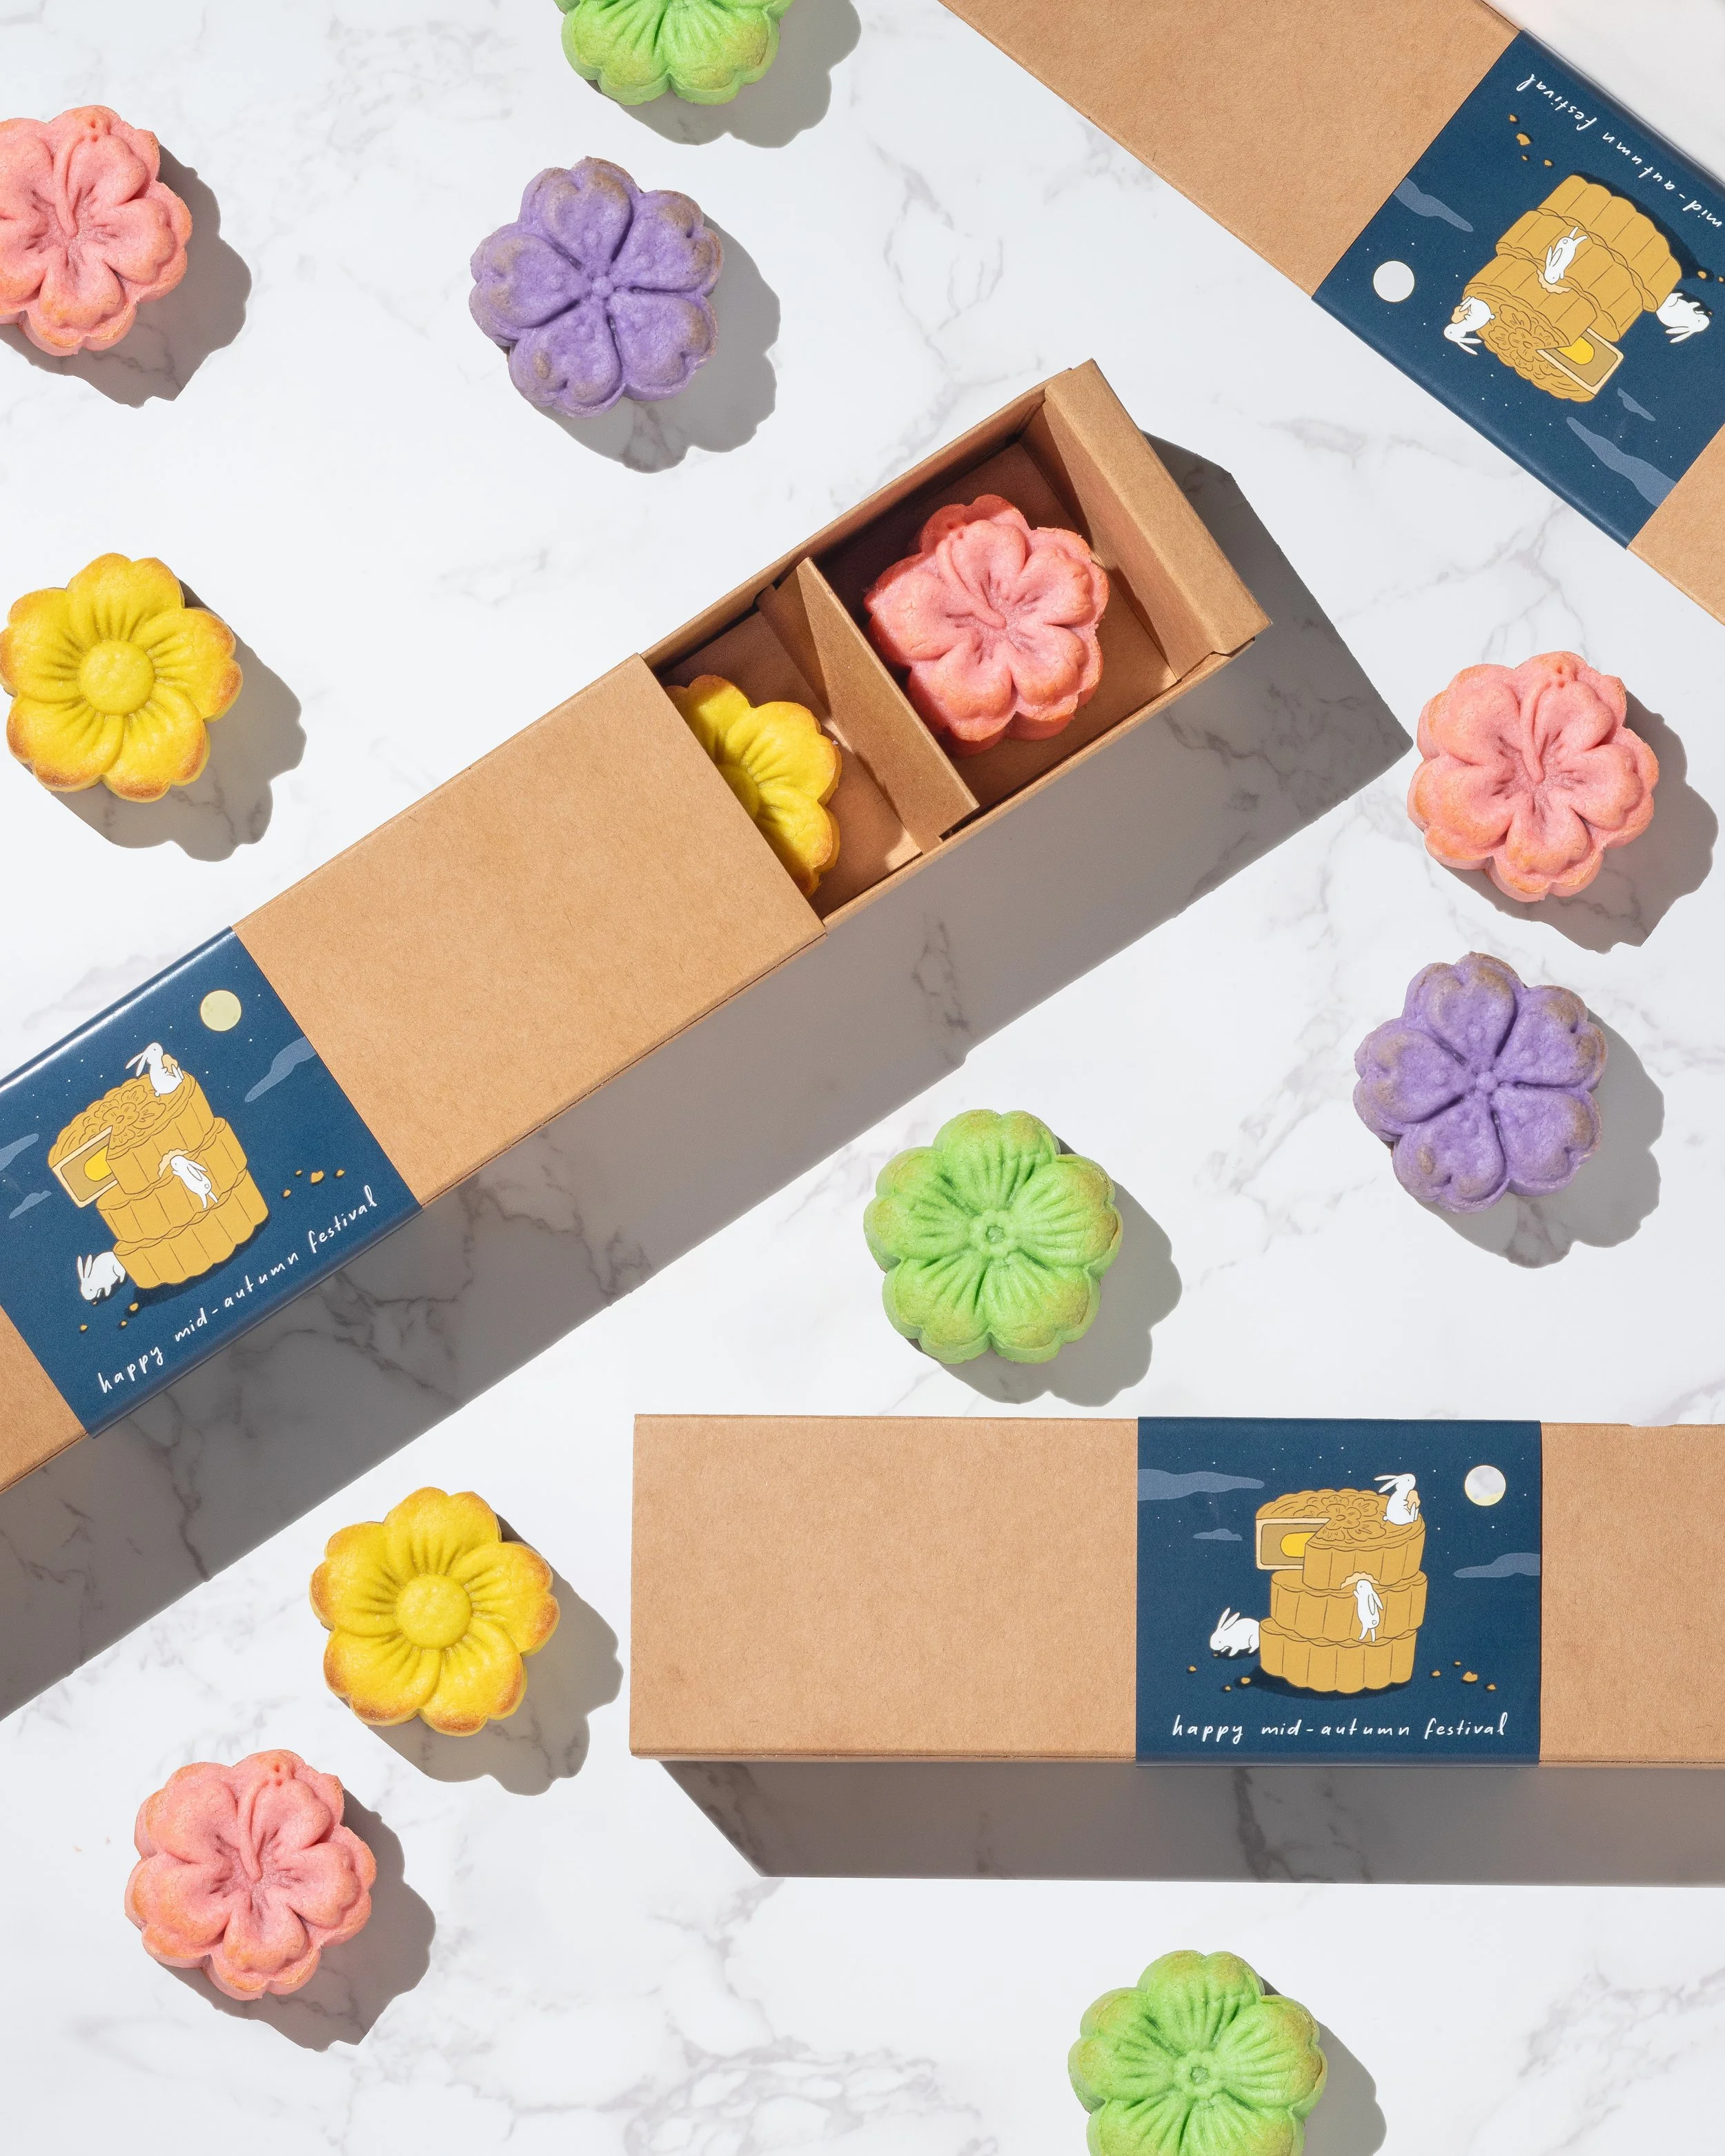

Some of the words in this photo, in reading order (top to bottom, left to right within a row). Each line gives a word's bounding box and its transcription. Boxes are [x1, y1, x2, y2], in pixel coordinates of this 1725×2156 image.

[1516, 73, 1597, 131] festival
[1602, 132, 1723, 228] mid-autumn
[97, 1346, 164, 1394] happy
[175, 1252, 299, 1342] mid-autumn
[308, 1185, 377, 1254] festival
[1172, 1714, 1243, 1745] happy
[1261, 1718, 1410, 1736] mid-autumn
[1424, 1712, 1508, 1740] festival
